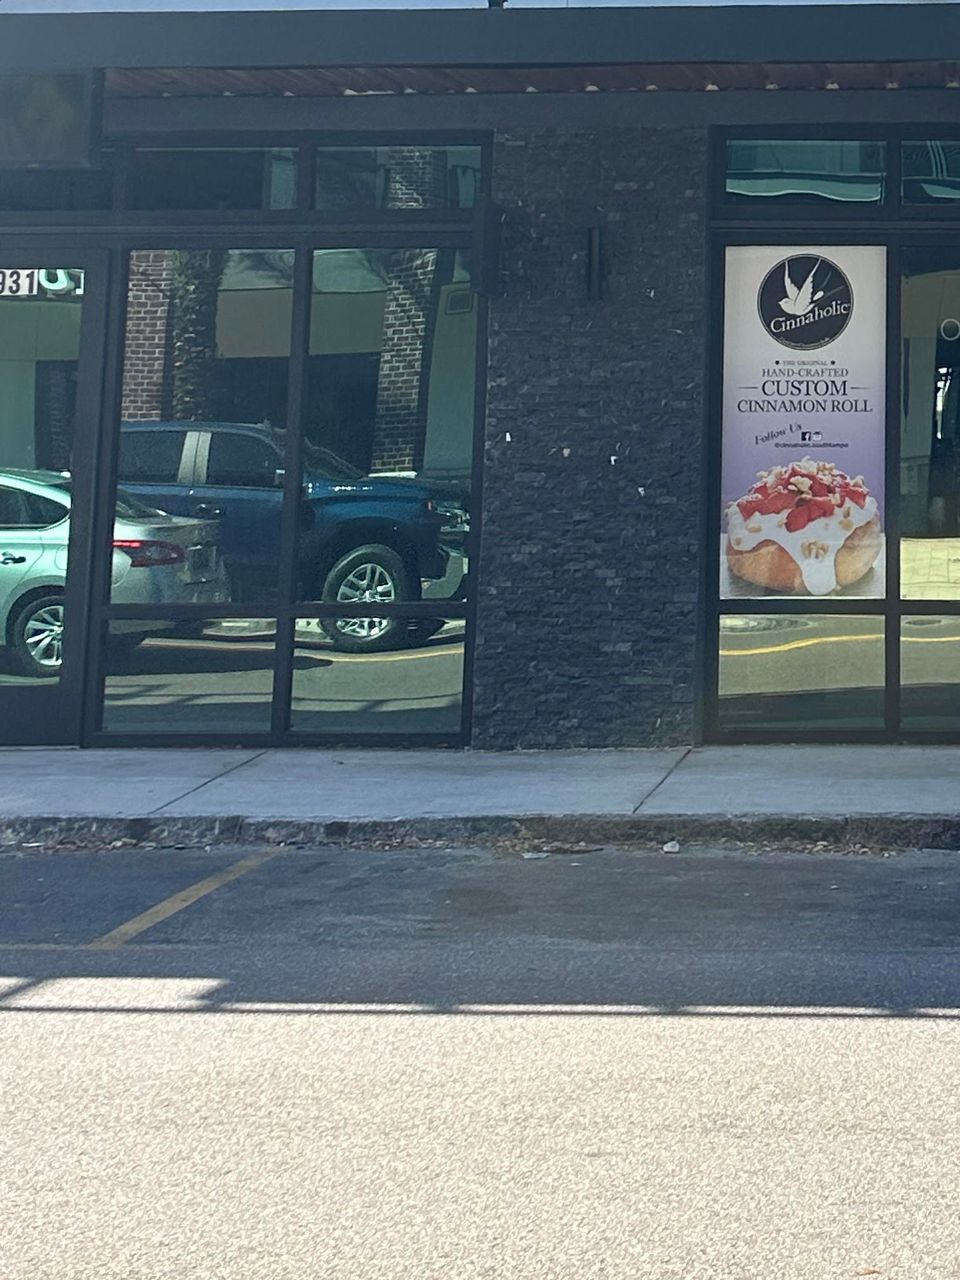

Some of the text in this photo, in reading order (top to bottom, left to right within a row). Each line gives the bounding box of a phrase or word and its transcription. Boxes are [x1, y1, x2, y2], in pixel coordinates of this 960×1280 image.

[770, 300, 850, 333] Cinnaholic
[762, 368, 849, 377] HAND-CRAFTED
[761, 380, 848, 396] CUSTOM
[737, 399, 873, 413] CINNAMON ROLL
[755, 428, 786, 445] Follow
